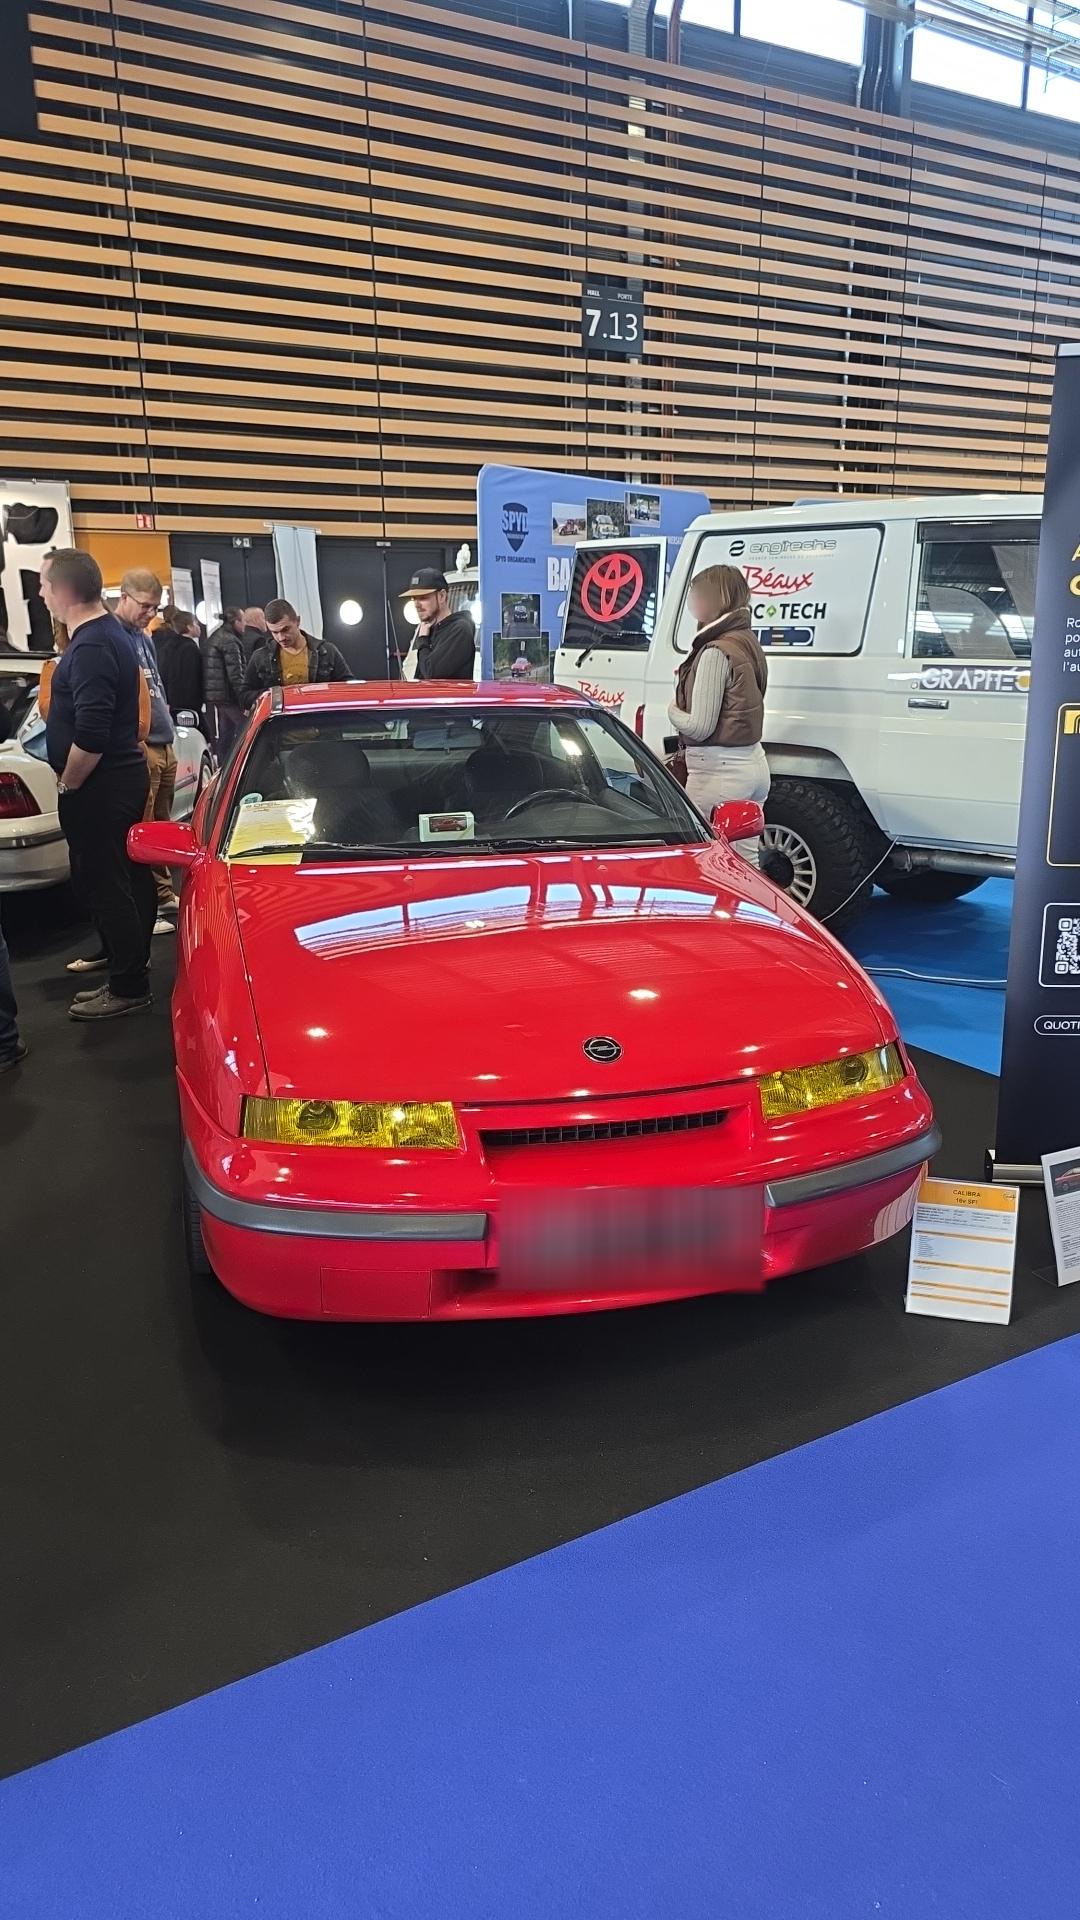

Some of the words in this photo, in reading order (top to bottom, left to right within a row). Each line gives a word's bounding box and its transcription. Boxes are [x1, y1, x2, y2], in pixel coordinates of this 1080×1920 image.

[585, 308, 638, 341] 7.13
[501, 510, 529, 532] SPYD
[547, 557, 573, 591] BA
[742, 565, 814, 595] Béaux
[577, 680, 625, 704] Béaux
[952, 1189, 981, 1197] CALIBRA
